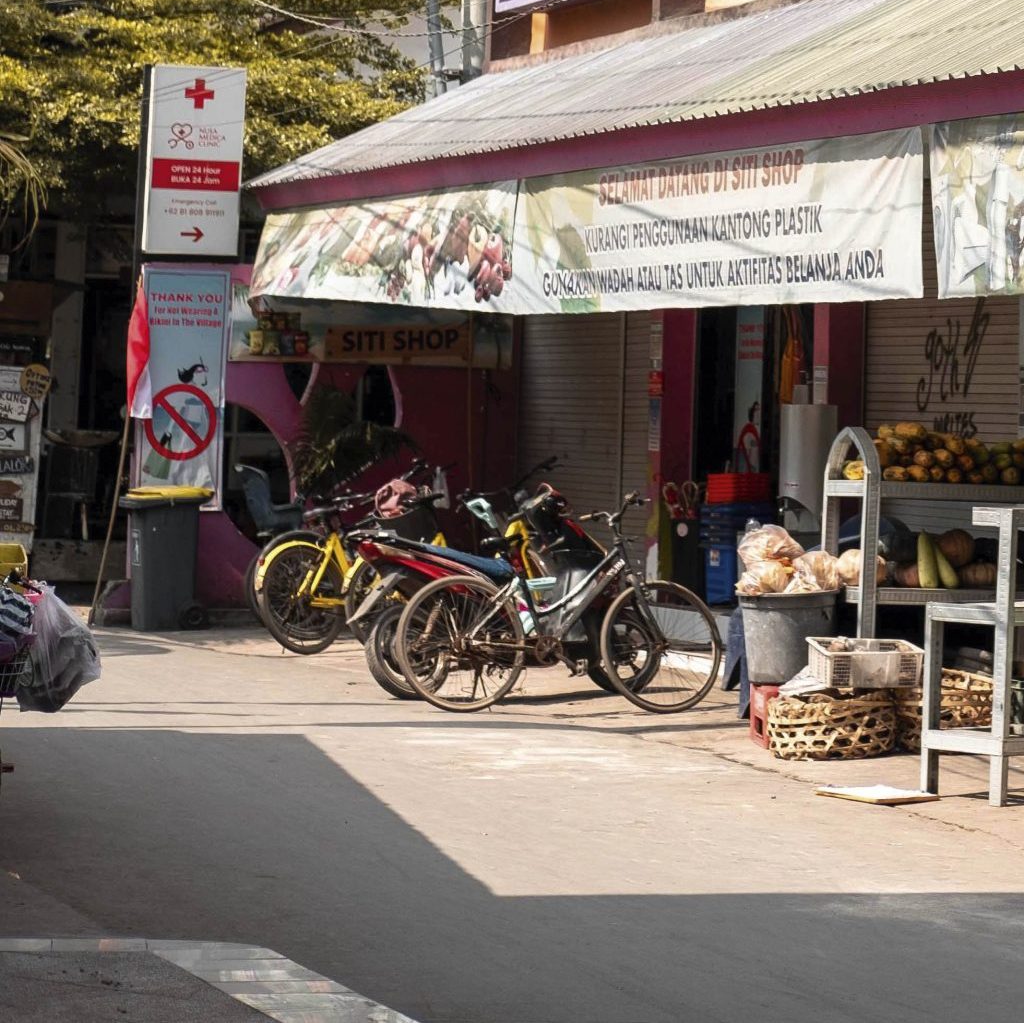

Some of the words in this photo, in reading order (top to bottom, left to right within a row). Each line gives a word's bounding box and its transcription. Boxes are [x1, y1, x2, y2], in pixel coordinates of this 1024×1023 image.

[170, 164, 191, 173] OPEN
[192, 166, 202, 174] 24
[170, 175, 191, 183] BUKA
[192, 176, 202, 184] 24
[598, 169, 657, 207] SELAMAT
[658, 160, 710, 200] DATANG
[713, 158, 728, 193] DI
[732, 154, 758, 192] SITI
[762, 148, 805, 188] SHOP
[584, 223, 630, 253] KURANGI
[632, 215, 708, 249] PENGGUNAAN
[711, 209, 771, 242] KANTONG
[775, 204, 823, 236] PLASTIK
[597, 266, 634, 295] WADAH
[637, 265, 663, 291] ATAU
[664, 263, 684, 290] TAS
[685, 259, 724, 289] UNTUK
[727, 255, 783, 286] AKTIFITAS
[786, 252, 842, 284] BELANJA
[844, 248, 885, 280] ANDA
[150, 293, 193, 302] THANK
[197, 293, 223, 303] YOU
[342, 330, 386, 352] SITI
[392, 328, 459, 351] SHOP
